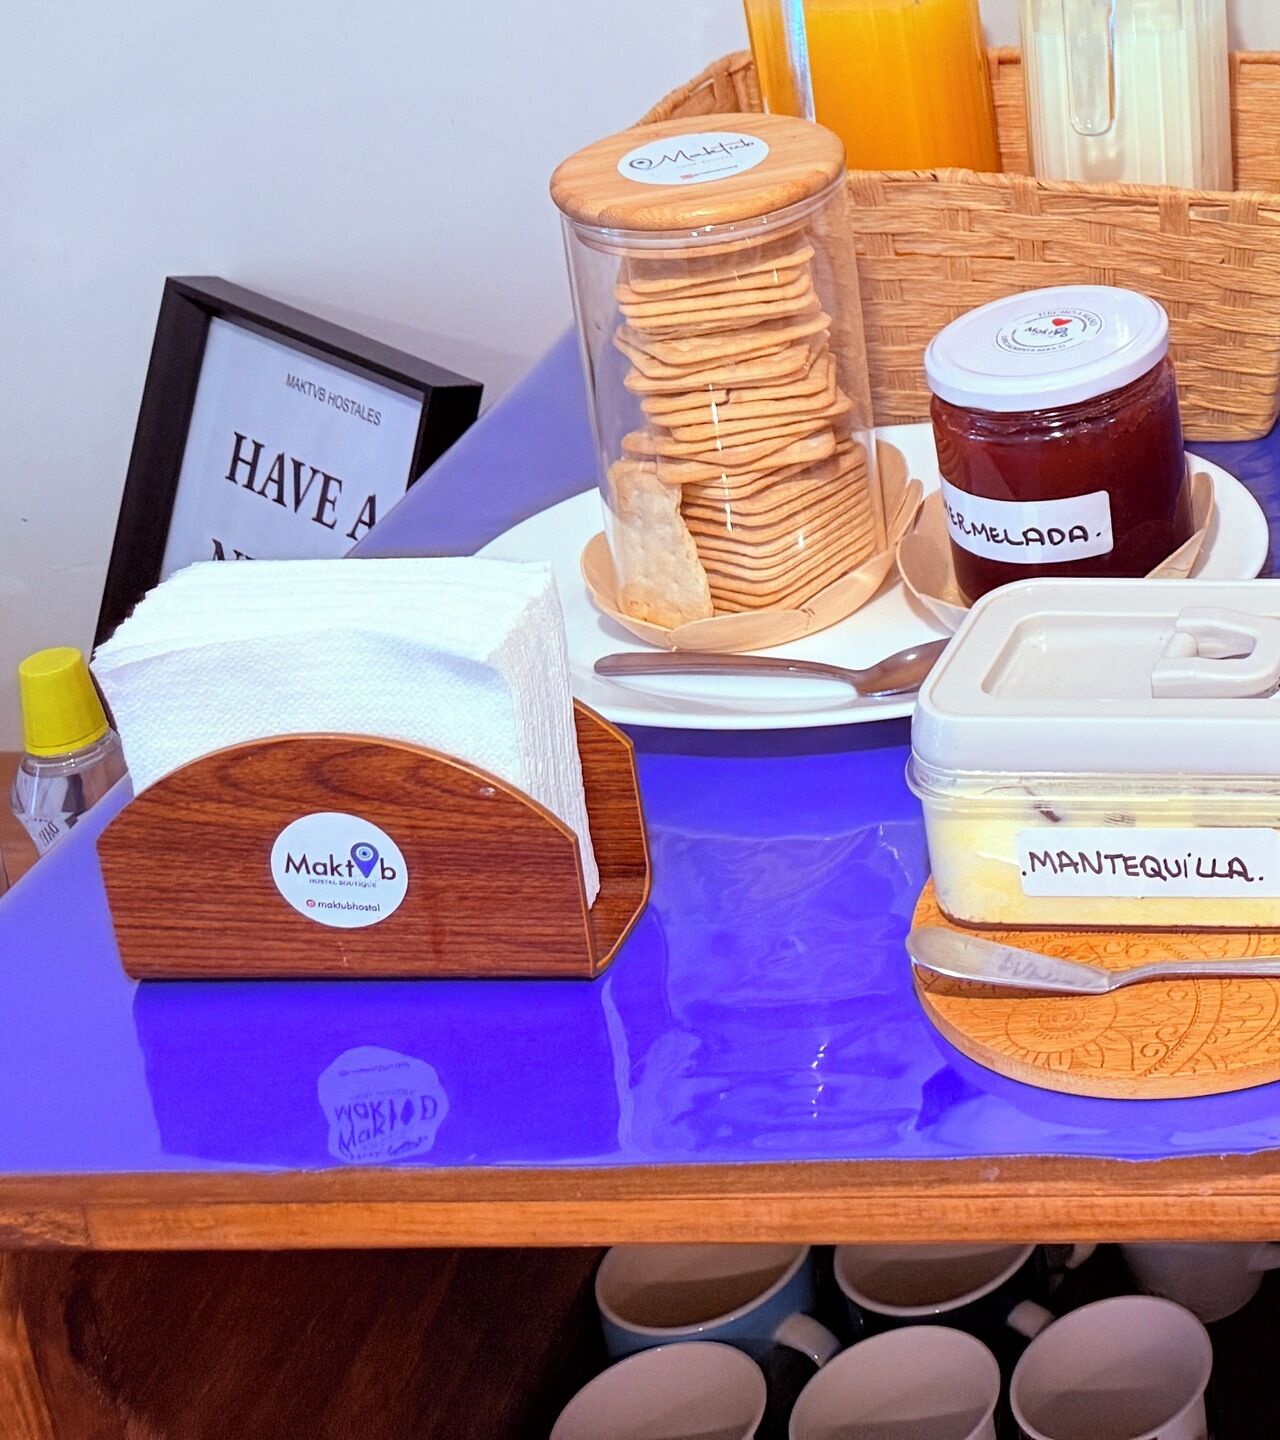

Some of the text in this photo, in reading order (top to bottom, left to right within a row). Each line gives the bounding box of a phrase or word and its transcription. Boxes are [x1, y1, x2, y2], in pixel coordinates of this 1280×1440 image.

[286, 372, 382, 427] MAKTVB HOSTALES
[225, 431, 343, 530] HAVE
